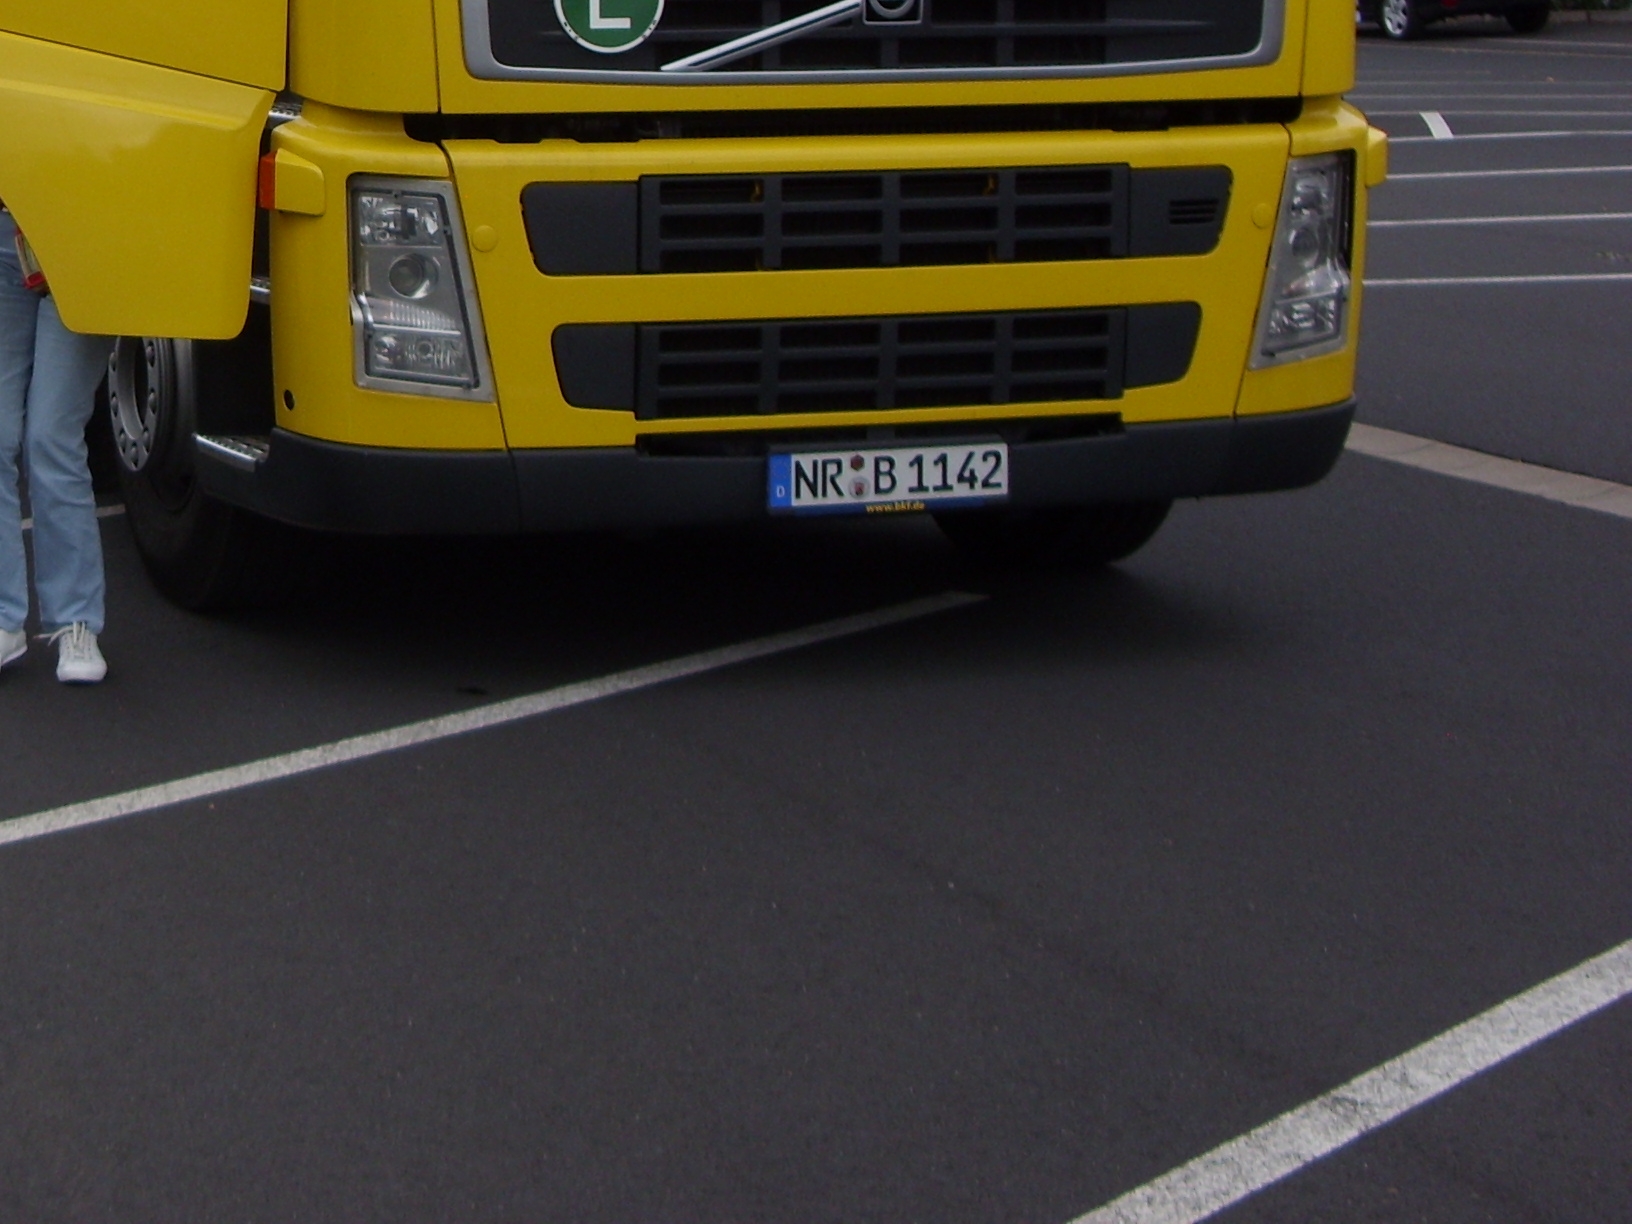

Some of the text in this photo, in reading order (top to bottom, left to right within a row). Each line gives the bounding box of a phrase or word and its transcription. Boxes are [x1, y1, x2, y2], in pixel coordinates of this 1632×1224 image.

[794, 449, 1003, 499] NR B 1142
[776, 484, 786, 499] D
